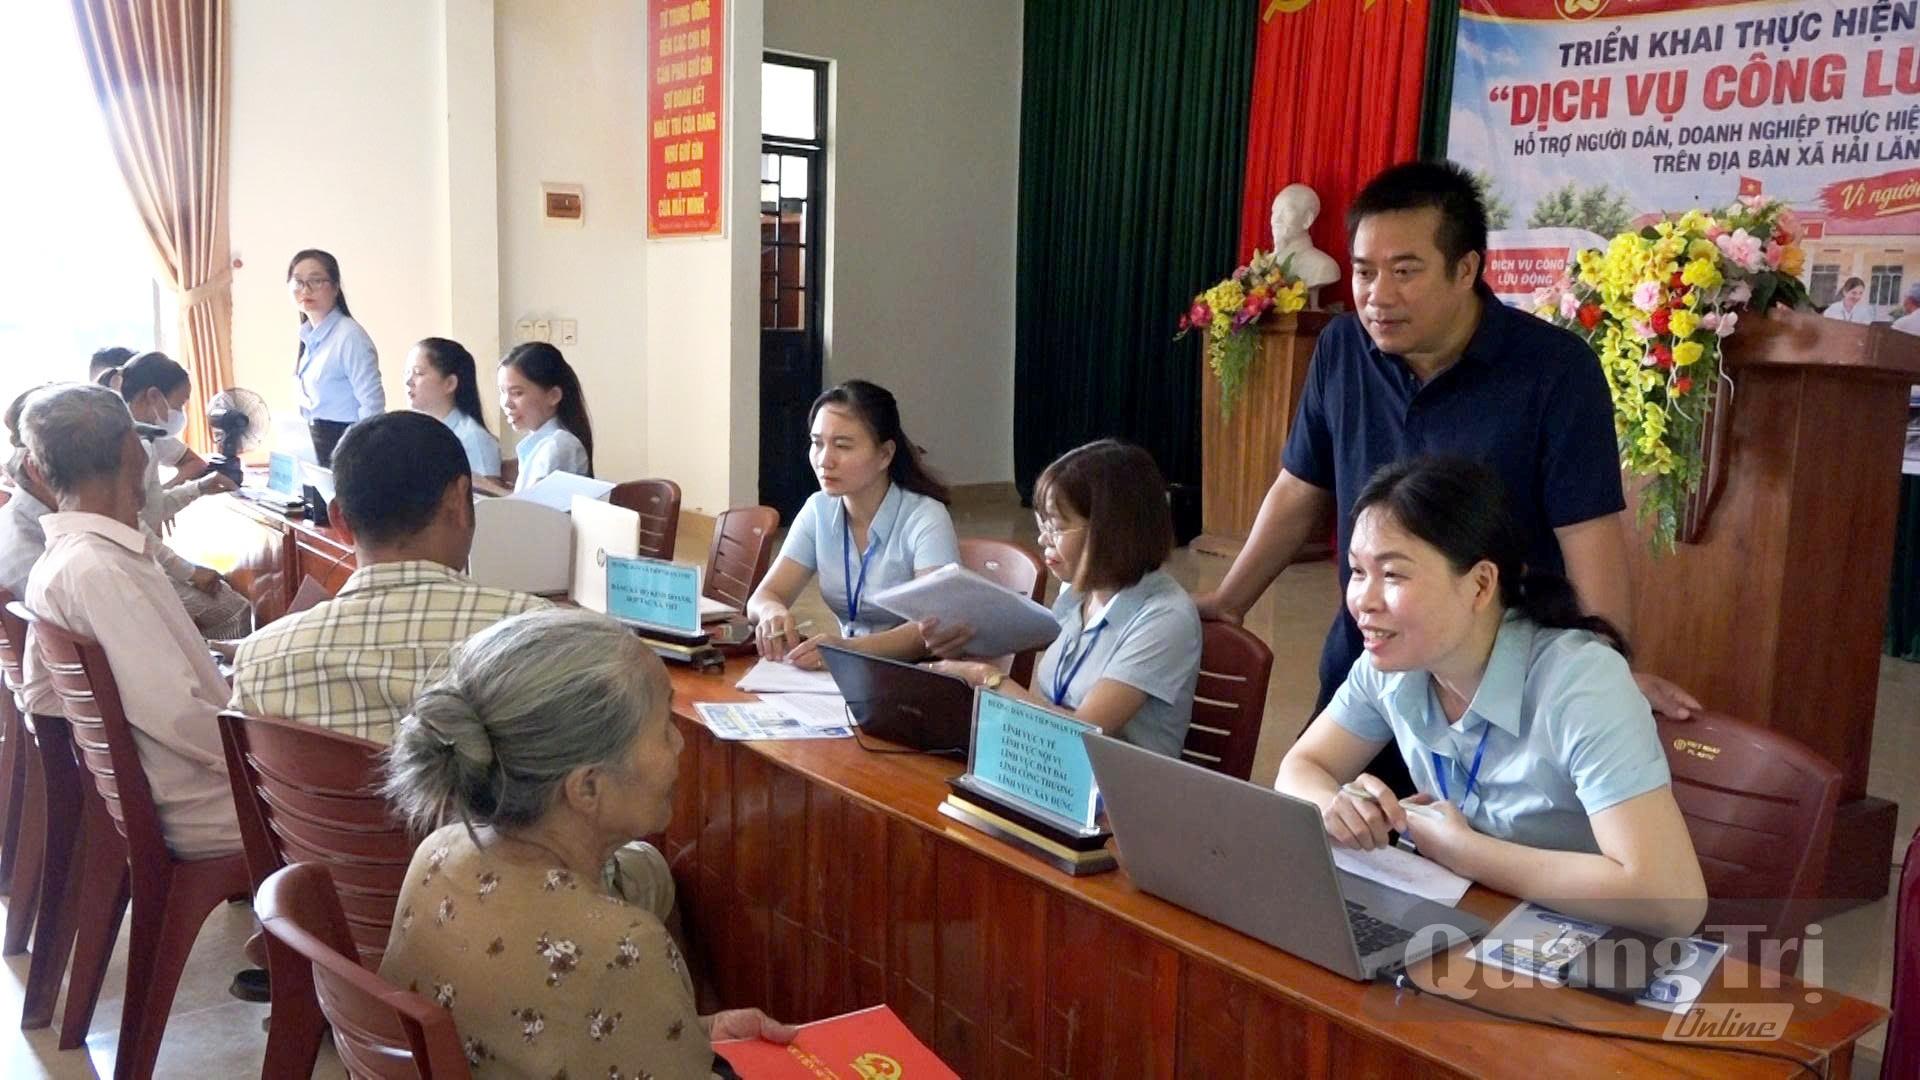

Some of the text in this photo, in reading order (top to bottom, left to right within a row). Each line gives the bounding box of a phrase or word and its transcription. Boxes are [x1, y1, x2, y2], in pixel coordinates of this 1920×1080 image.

[1559, 0, 1918, 67] TRIỂN KHAI THỰC HIỆN
[1626, 69, 1689, 122] VỤ
[1703, 52, 1847, 111] CÔNG
[1514, 132, 1535, 156] HỖ
[1540, 133, 1572, 157] TRỢ
[1576, 128, 1627, 152] NGƯỜI
[1632, 125, 1673, 149] DÂN,
[1678, 123, 1743, 146] DOANH
[1749, 113, 1821, 142] NGHIỆP
[1826, 109, 1880, 138] THỰC
[1652, 149, 1701, 173] TRÊN
[1707, 150, 1741, 175] ĐỊA
[1748, 144, 1790, 168] BÀN
[1795, 141, 1825, 166] XÃ
[1832, 135, 1869, 164] HẢI
